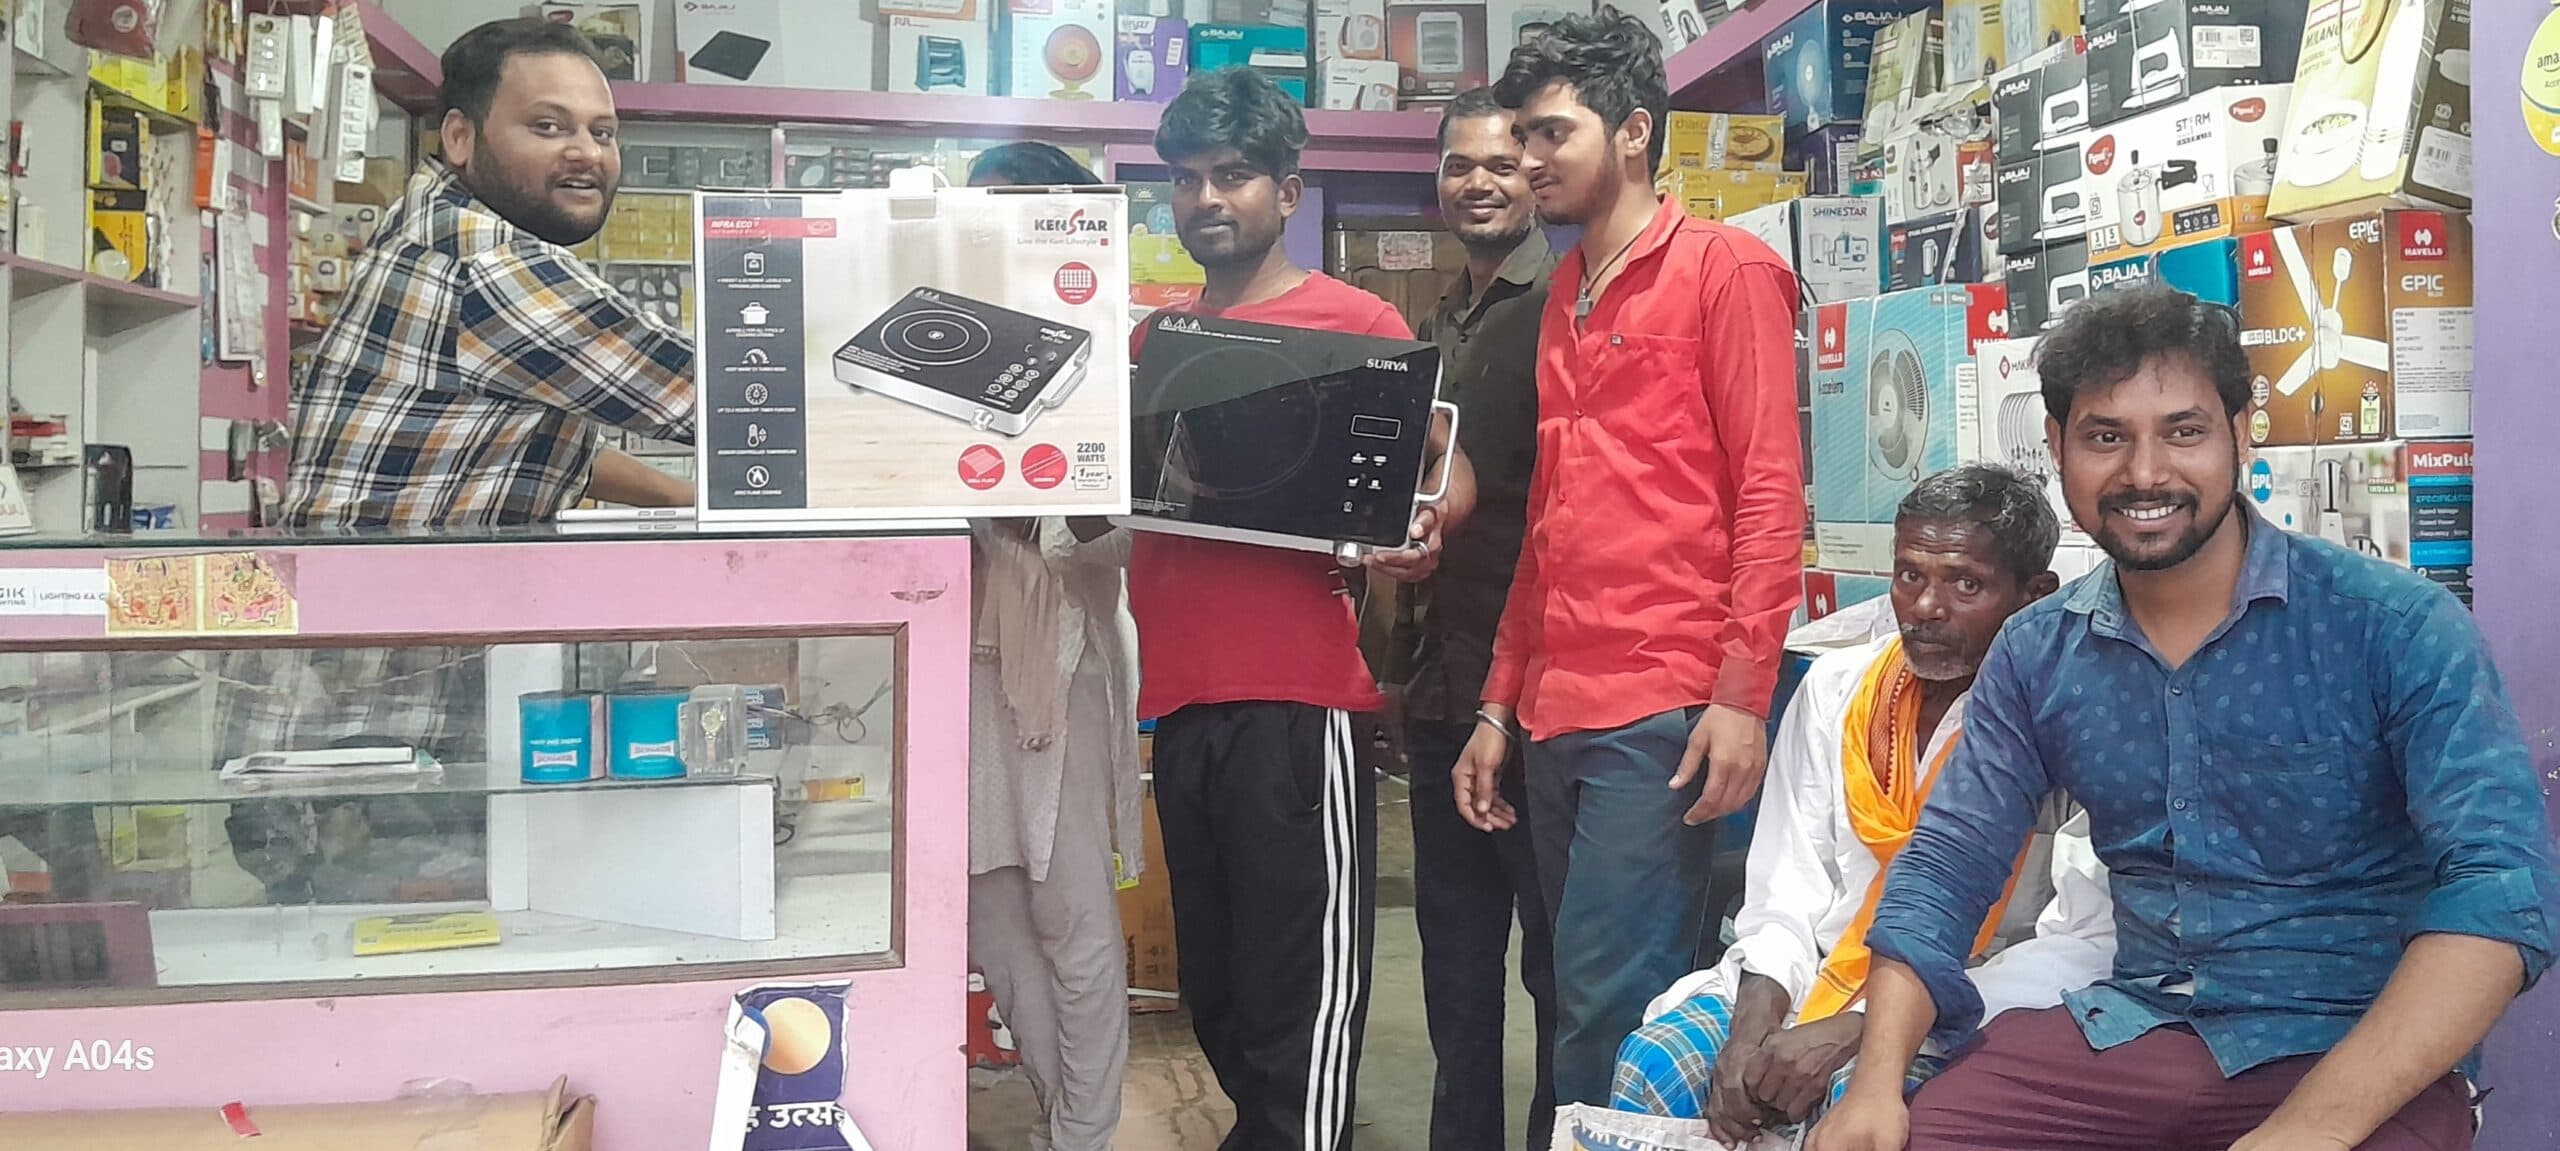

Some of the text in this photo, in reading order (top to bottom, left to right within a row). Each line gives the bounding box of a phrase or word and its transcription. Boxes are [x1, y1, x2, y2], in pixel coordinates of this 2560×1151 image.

[1854, 11, 1904, 22] BAJAJ
[1812, 206, 1868, 217] SHINESTAR
[711, 220, 753, 228] INFRA ECO
[1034, 208, 1108, 235] KENSTAR
[2349, 219, 2380, 239] EPIC
[2404, 247, 2443, 256] HAVELLS
[2247, 265, 2272, 277] HAVELLS
[2401, 275, 2445, 291] EPIC
[2264, 327, 2307, 344] BLDC+
[1819, 352, 1843, 365] HAVELLS
[1366, 358, 1408, 372] SURYA
[1076, 442, 1106, 453] 2200
[1077, 454, 1106, 463] WATTS
[1079, 467, 1085, 477] 1
[2251, 473, 2272, 490] BPL
[2369, 485, 2396, 493] INDIAN
